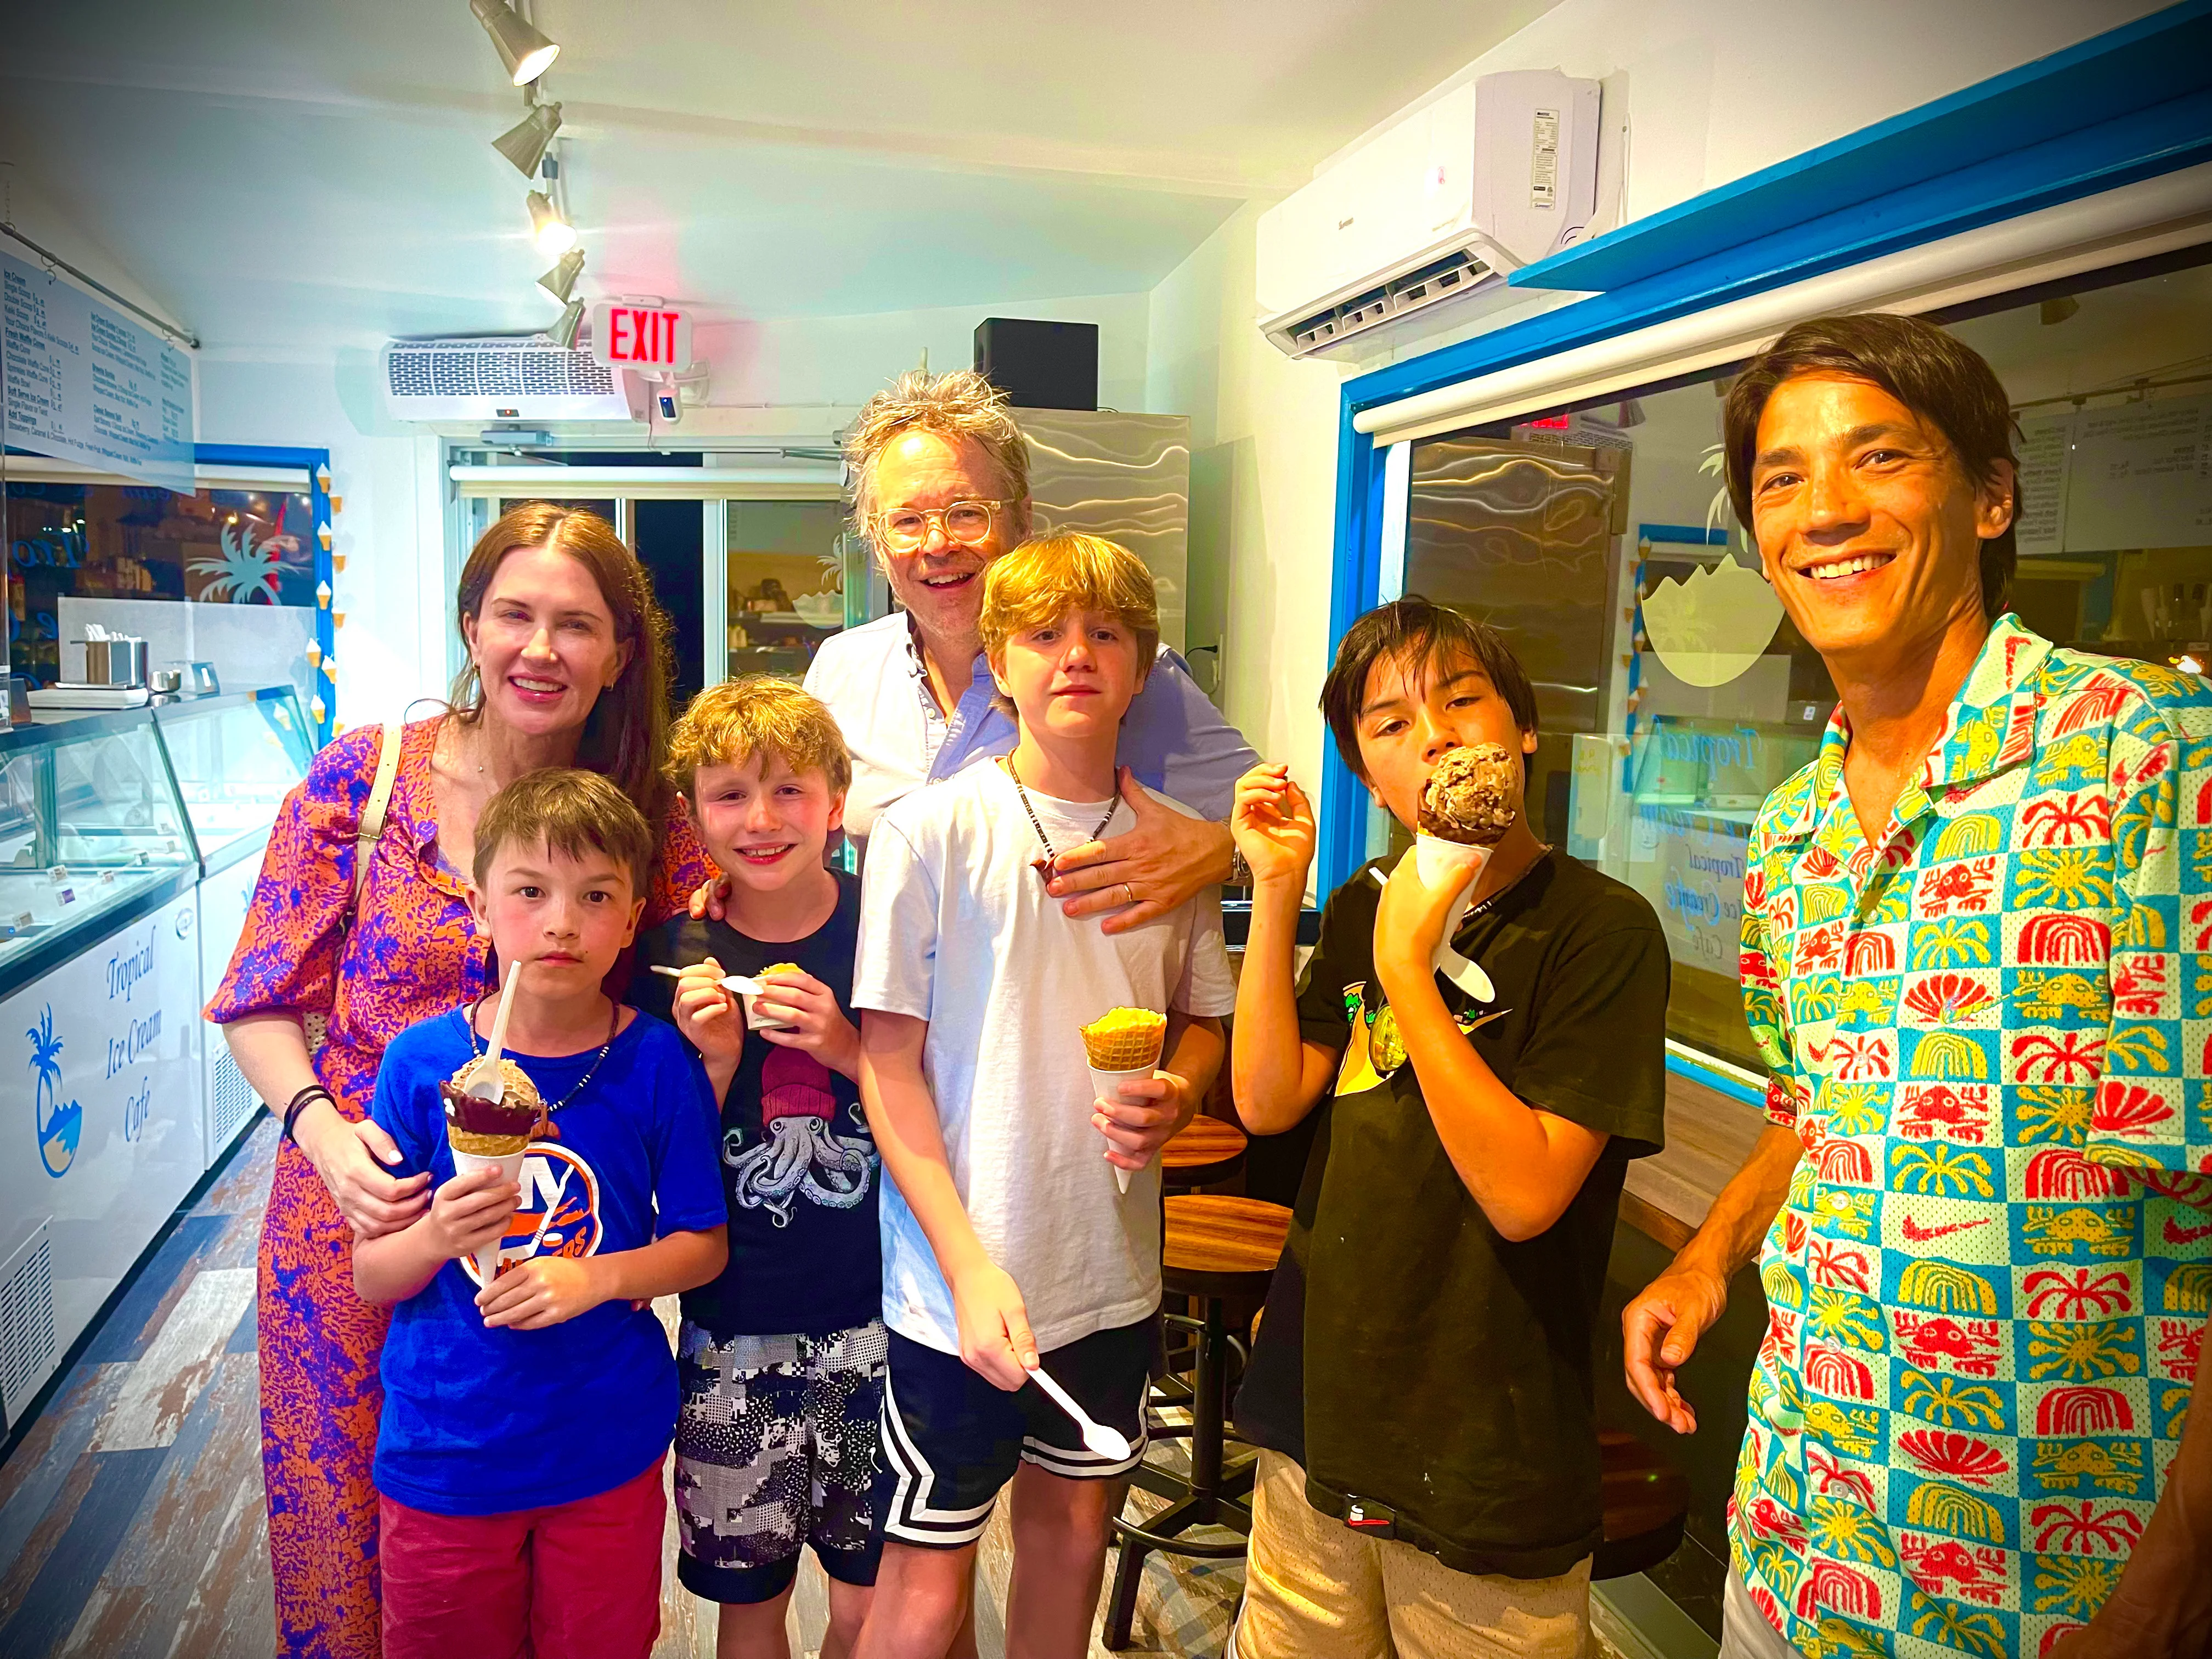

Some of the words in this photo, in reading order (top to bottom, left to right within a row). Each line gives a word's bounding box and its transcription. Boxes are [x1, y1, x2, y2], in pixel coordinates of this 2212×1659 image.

[609, 307, 681, 365] EXIT
[106, 924, 157, 1002] Tropical
[106, 1037, 124, 1080] Ice
[128, 1008, 163, 1065] Cream
[125, 1076, 150, 1143] Cafe
